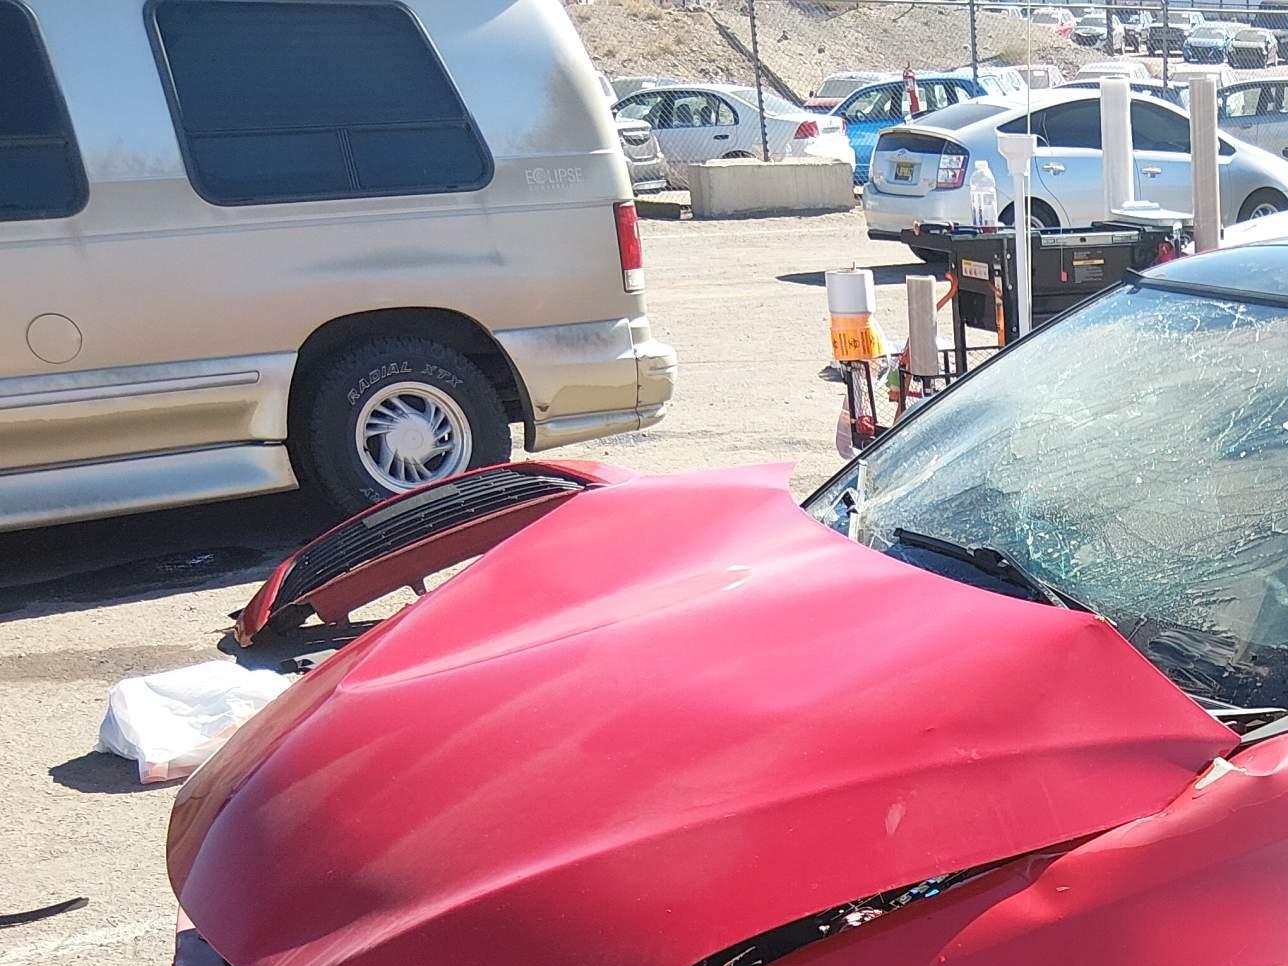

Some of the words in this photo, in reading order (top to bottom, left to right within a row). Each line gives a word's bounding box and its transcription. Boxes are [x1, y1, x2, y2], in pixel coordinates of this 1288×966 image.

[525, 167, 583, 185] ECLIPSE
[346, 361, 413, 405] RADIAL
[421, 363, 464, 388] XTX
